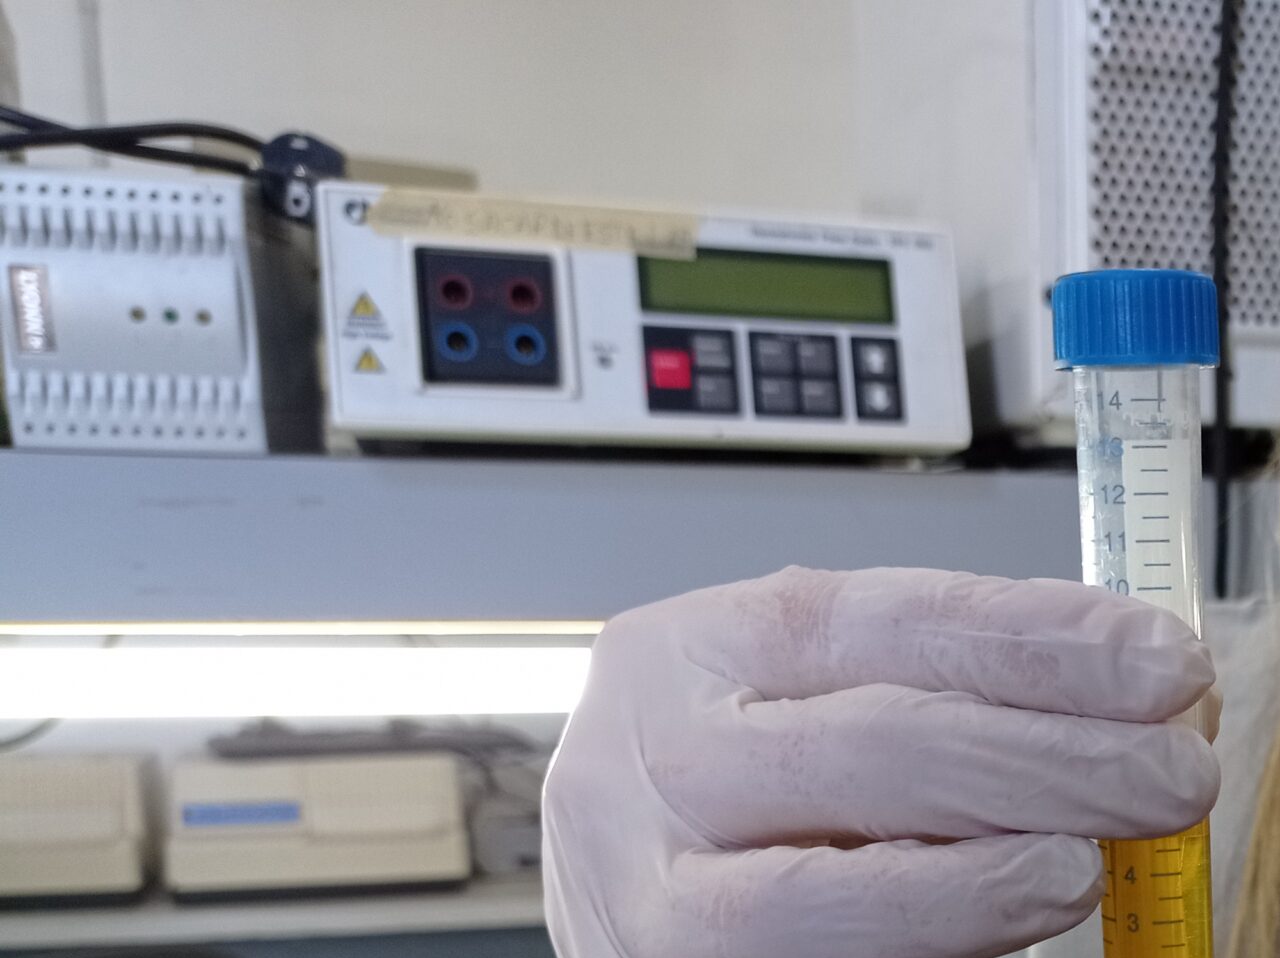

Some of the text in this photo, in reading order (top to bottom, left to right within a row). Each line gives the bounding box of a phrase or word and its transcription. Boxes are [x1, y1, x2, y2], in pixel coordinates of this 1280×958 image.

[1100, 484, 1126, 504] 12
[1103, 531, 1127, 552] 11
[1124, 866, 1136, 885] 4
[1127, 913, 1139, 932] 3
